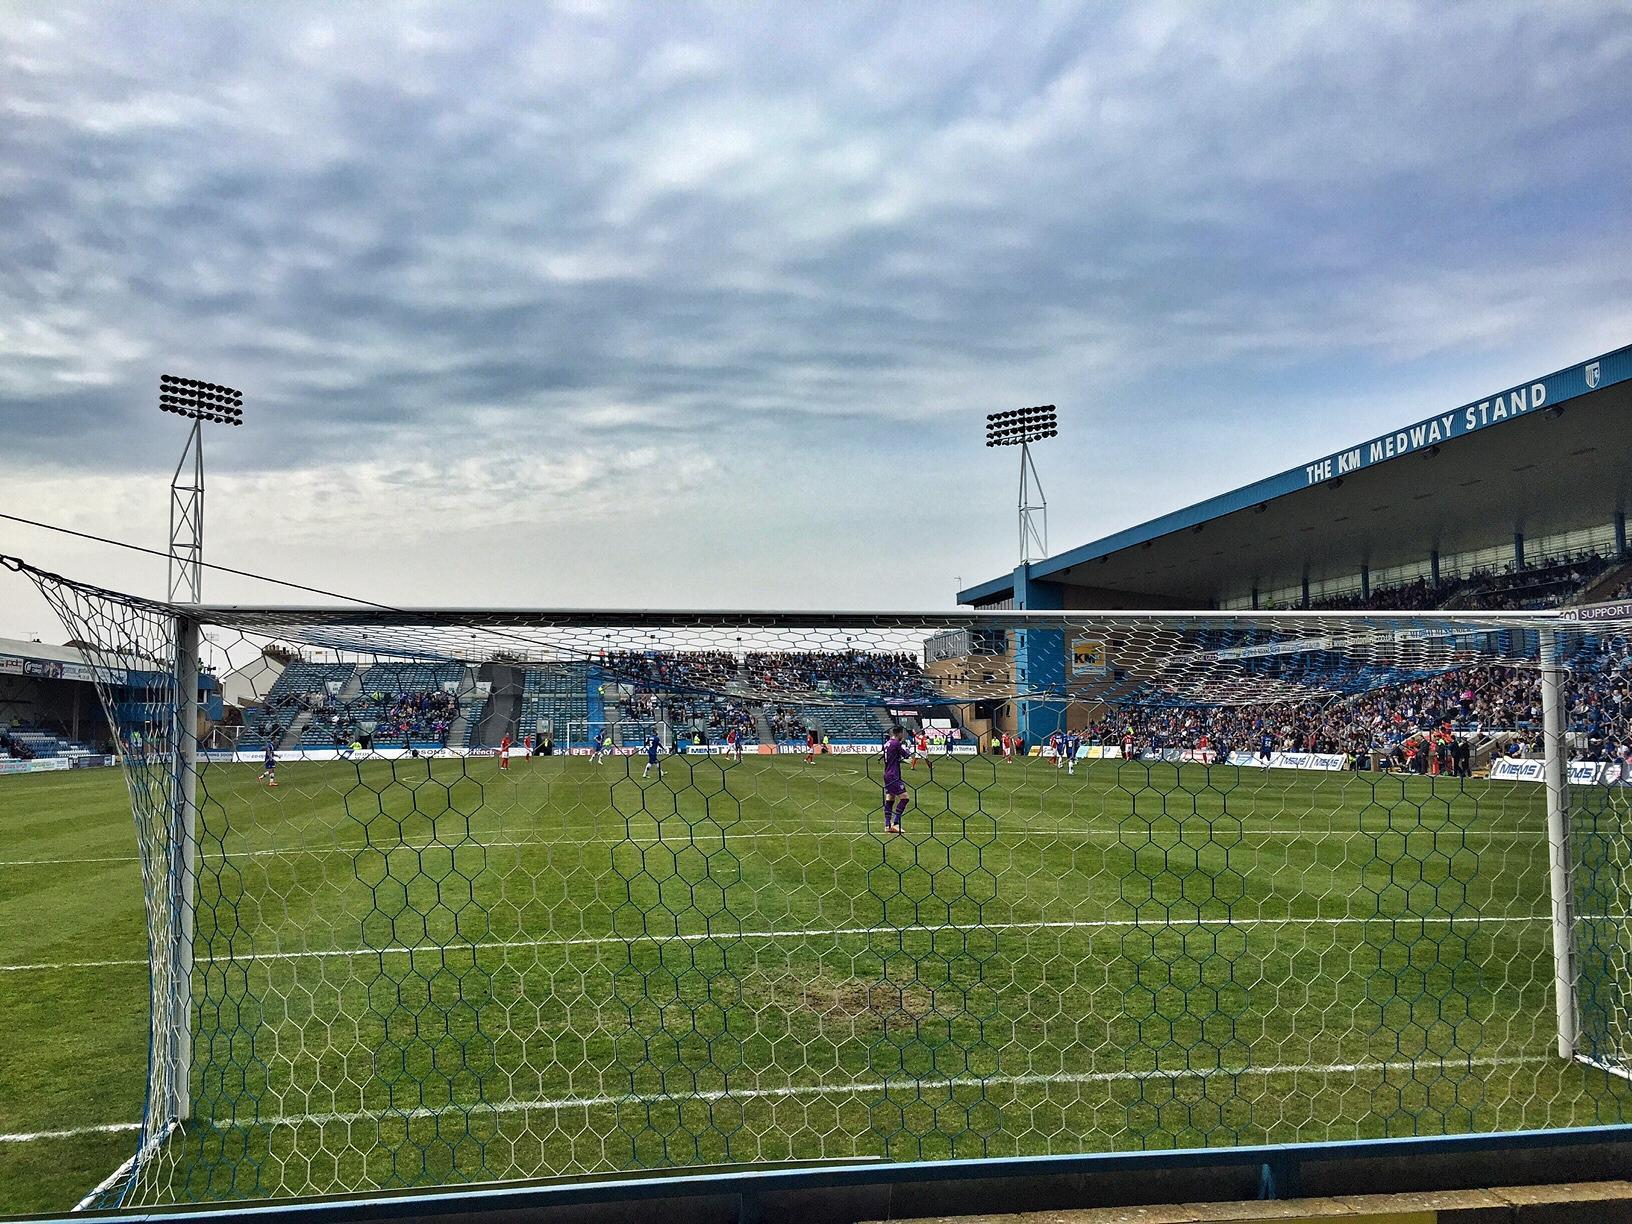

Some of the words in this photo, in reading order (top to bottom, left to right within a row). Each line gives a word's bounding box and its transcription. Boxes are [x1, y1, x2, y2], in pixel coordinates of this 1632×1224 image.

[1306, 459, 1332, 484] THE
[1338, 448, 1361, 473] KM
[1369, 414, 1454, 464] MEDWAY
[1465, 383, 1547, 431] STAND
[1581, 605, 1631, 619] SUPPORT
[572, 748, 591, 756] BET
[833, 745, 868, 753] MASTER
[1282, 756, 1307, 766] MEMS
[1313, 758, 1339, 767] MEMS
[1499, 763, 1537, 775] MEMS
[1567, 767, 1593, 778] EMS
